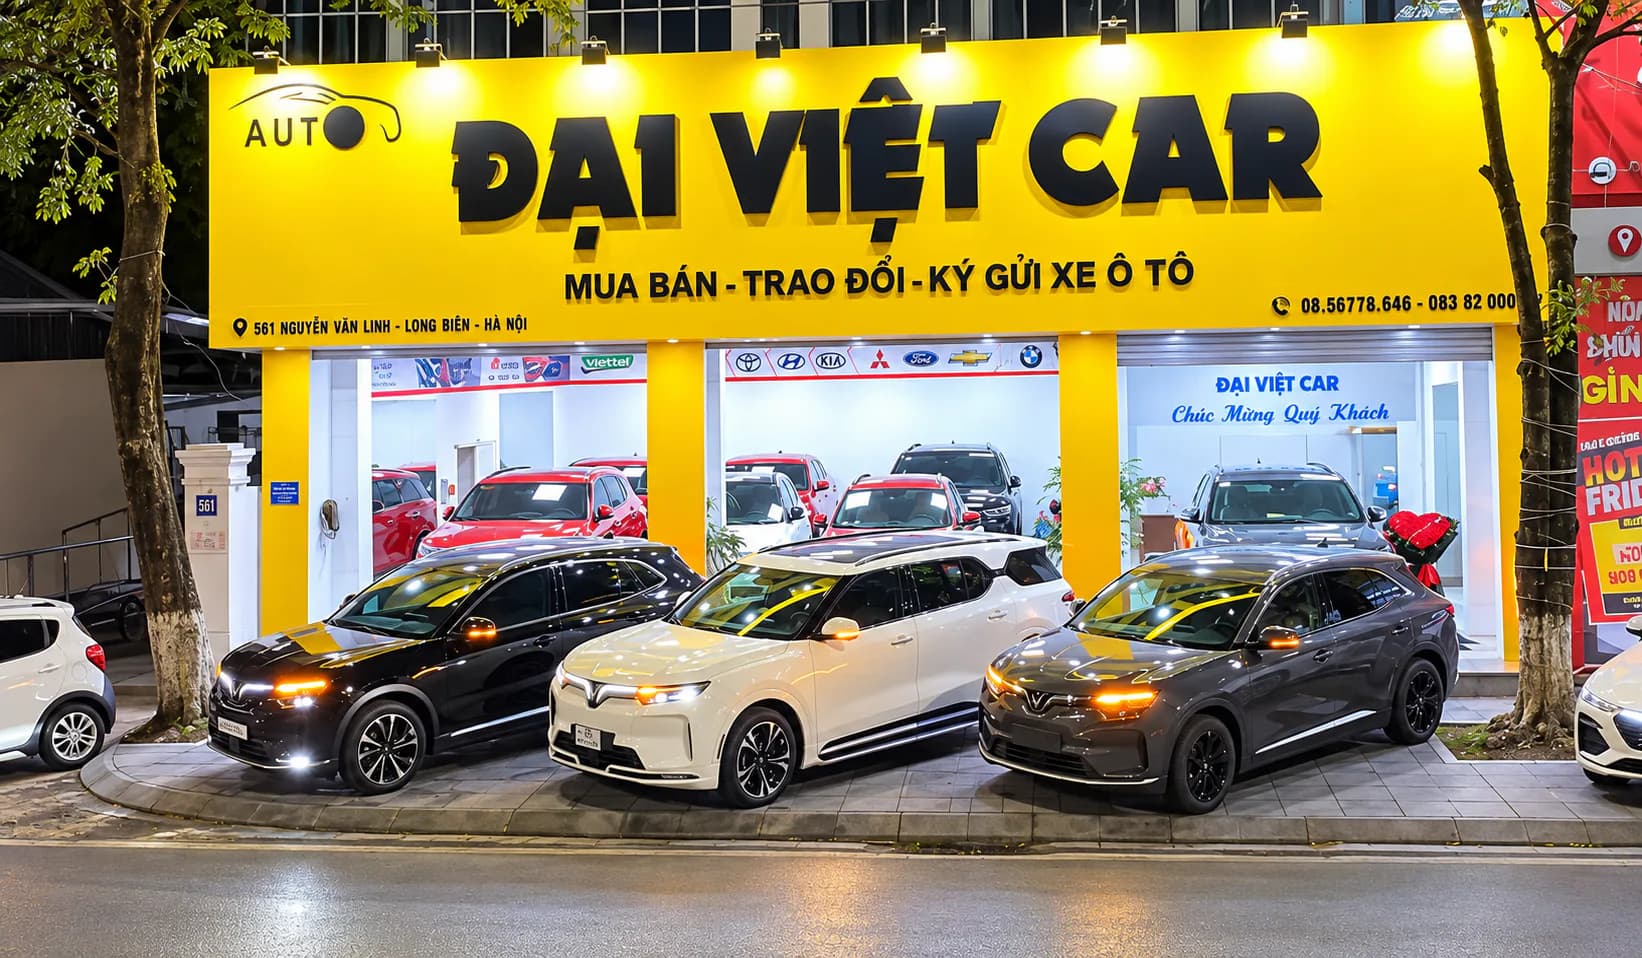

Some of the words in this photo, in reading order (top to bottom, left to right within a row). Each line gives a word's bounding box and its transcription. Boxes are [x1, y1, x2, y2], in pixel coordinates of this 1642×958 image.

[452, 114, 677, 250] ĐẠI
[710, 77, 1002, 243] VIỆT
[1029, 92, 1323, 207] CAR
[565, 272, 639, 300] MUA
[649, 264, 717, 298] BÁN
[742, 268, 835, 297] TRAO
[844, 254, 905, 294] ĐỔI
[929, 258, 975, 293] KÝ
[985, 253, 1041, 291] GỬI
[1050, 261, 1097, 289] XE
[1107, 252, 1133, 288] Ô
[1144, 250, 1194, 287] TÔ
[1301, 296, 1412, 314] 08.56778.646
[1428, 295, 1458, 311] 083
[1463, 294, 1482, 310] 82
[254, 321, 275, 336] 561
[280, 316, 328, 335] NGUYỄN
[333, 317, 358, 334] VĂN
[363, 319, 391, 333] LINH
[405, 319, 437, 333] LONG
[442, 315, 470, 332] BIÊN
[484, 314, 501, 331] HÀ
[506, 314, 527, 334] NỘI
[585, 355, 631, 368] viettel
[820, 355, 843, 366] KIA
[1215, 376, 1250, 397] ĐẠI
[1254, 371, 1296, 397] VIỆT
[1299, 375, 1340, 392] CAR
[1171, 405, 1215, 423] Chúc
[1221, 404, 1275, 426] Mừng
[1284, 404, 1320, 425] Quý
[1328, 402, 1390, 421] Khách
[198, 499, 215, 512] 561
